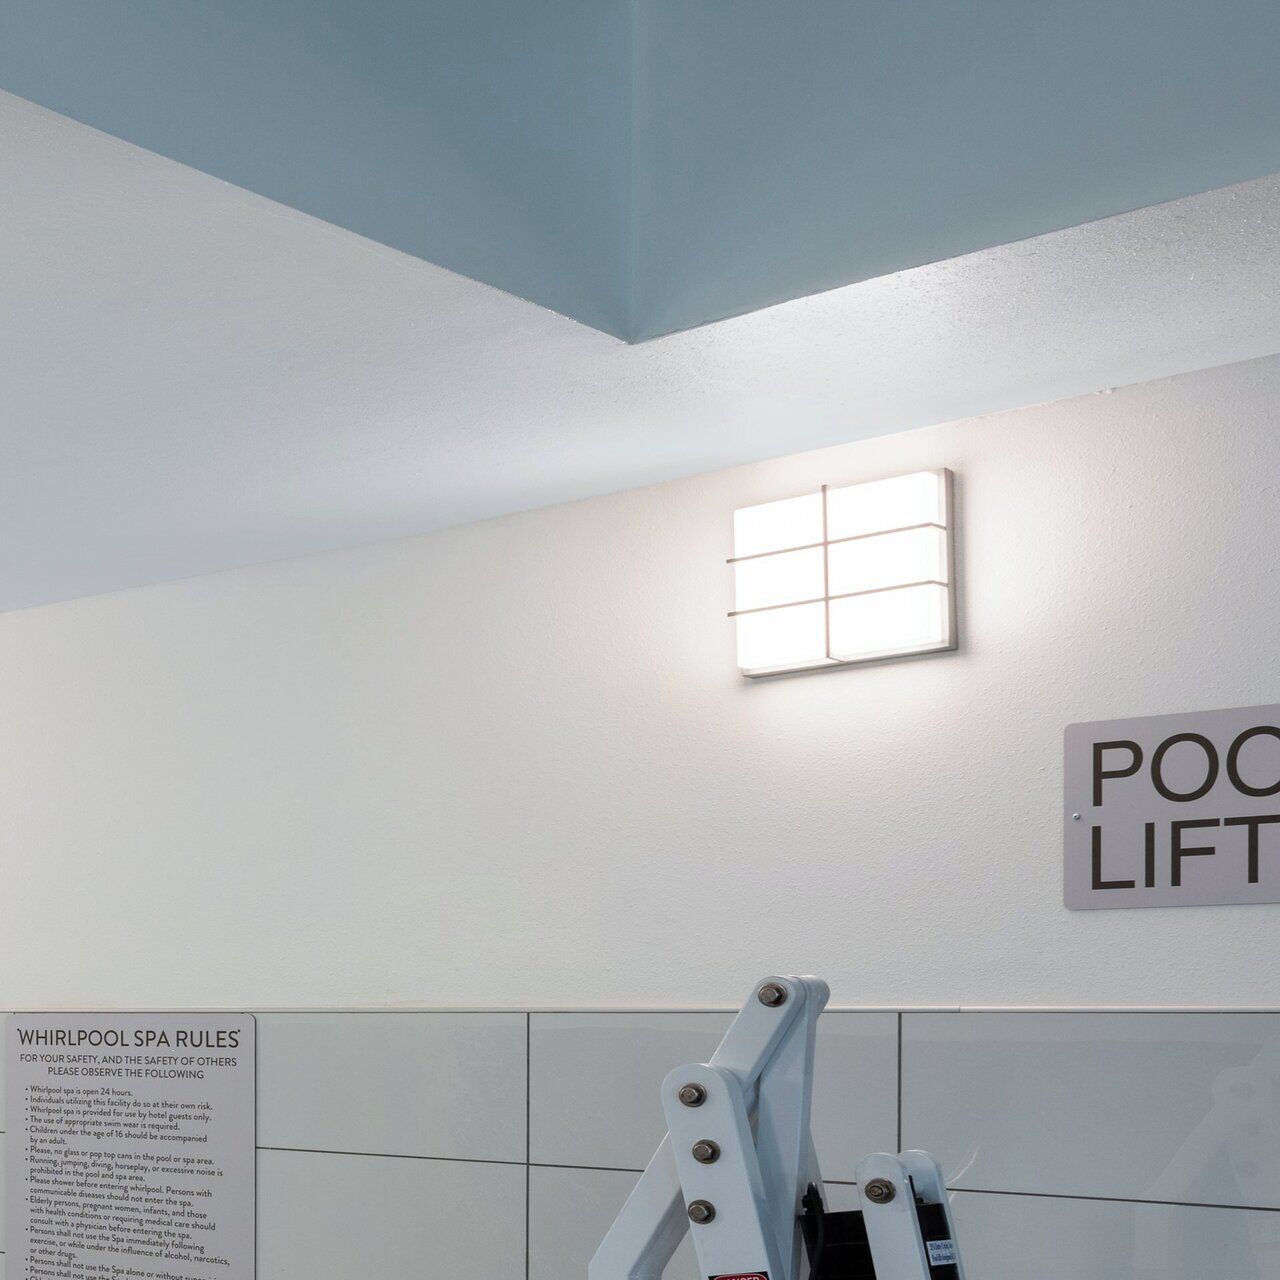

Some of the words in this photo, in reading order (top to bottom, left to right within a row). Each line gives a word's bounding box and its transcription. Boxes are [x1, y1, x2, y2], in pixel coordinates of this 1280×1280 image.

[1092, 815, 1280, 890] LIFT
[19, 1029, 129, 1047] WHIRLPOOL
[134, 1030, 170, 1047] SPA
[176, 1030, 239, 1049] RULES
[20, 1053, 38, 1061] FOR
[38, 1054, 64, 1062] YOUR
[66, 1054, 99, 1064] SAFETY,
[101, 1055, 122, 1064] AND
[124, 1056, 142, 1064] THE
[144, 1056, 179, 1065] SAFETY
[180, 1057, 195, 1066] OF
[196, 1058, 237, 1067] OTHERS
[47, 1066, 79, 1075] PLEASE
[80, 1067, 122, 1077] OBSERVE
[124, 1069, 142, 1077] THE
[145, 1069, 204, 1079] FOLLOWING
[30, 1085, 62, 1095] Whirlpool
[82, 1089, 99, 1097] open
[100, 1088, 110, 1096] 24
[111, 1089, 133, 1097] hours.
[30, 1096, 64, 1104] Individuals
[65, 1098, 92, 1107] utilizing
[93, 1098, 106, 1106] this
[107, 1099, 131, 1109] facility
[132, 1100, 141, 1108] do
[197, 1103, 212, 1111] risk.
[30, 1106, 62, 1115] Whirlpool
[82, 1109, 111, 1117] provided
[138, 1111, 147, 1120] by
[148, 1111, 167, 1119] hotel
[168, 1114, 192, 1122] guests
[193, 1114, 211, 1124] only.
[64, 1119, 102, 1127] appropriate
[147, 1123, 180, 1132] required.
[29, 1126, 58, 1134] Children
[92, 1131, 105, 1139] age
[105, 1130, 113, 1138] of
[124, 1131, 147, 1140] should
[159, 1135, 207, 1144] accompanied
[29, 1136, 38, 1145] by
[48, 1137, 67, 1145] adult.
[29, 1176, 50, 1184] Please
[51, 1178, 75, 1187] shower
[75, 1180, 98, 1188] before
[99, 1183, 128, 1193] entering
[129, 1185, 164, 1195] whirlpool.
[165, 1187, 194, 1196] Persons
[196, 1190, 212, 1198] with
[29, 1188, 77, 1197] communicable
[78, 1190, 105, 1199] diseases
[106, 1193, 129, 1202] should
[144, 1197, 163, 1205] enter
[165, 1198, 177, 1206] the
[29, 1257, 55, 1266] Persons
[56, 1260, 71, 1268] shall
[98, 1265, 110, 1273] the
[111, 1266, 124, 1276] Spa
[125, 1268, 145, 1277] alone
[155, 1272, 183, 1280] without
[29, 1267, 55, 1276] Persons
[56, 1270, 71, 1278] shall
